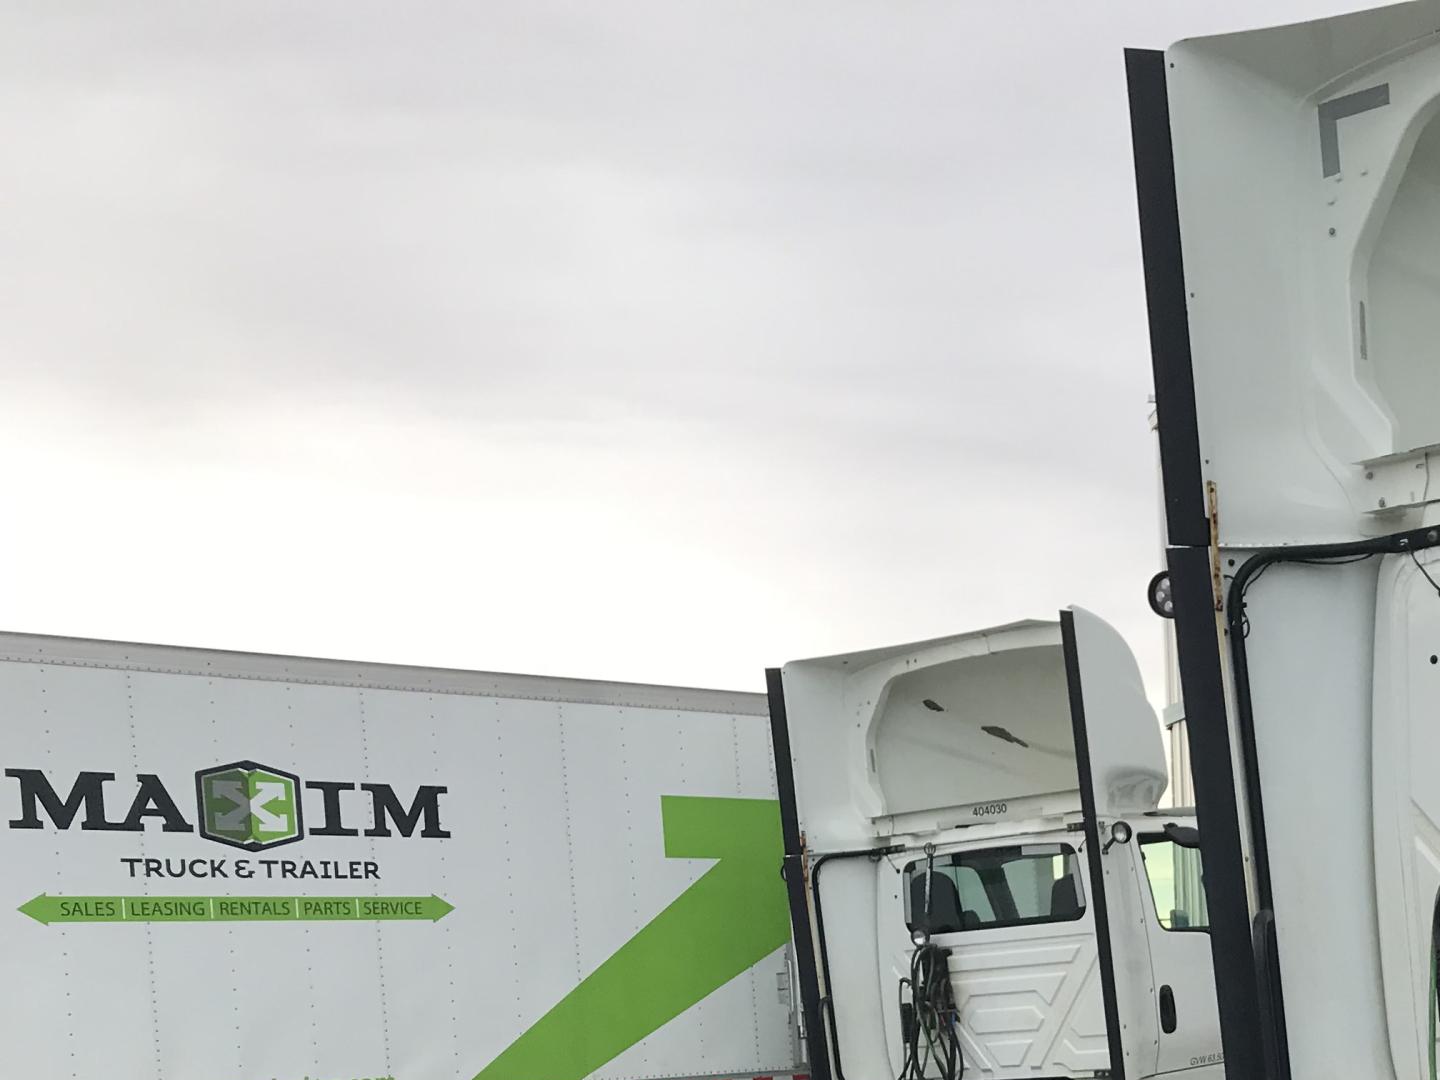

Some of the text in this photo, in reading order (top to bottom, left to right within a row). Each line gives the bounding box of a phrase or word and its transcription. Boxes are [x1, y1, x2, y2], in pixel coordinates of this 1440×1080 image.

[5, 760, 451, 853] MAXIM
[972, 803, 1007, 816] 404030
[120, 858, 381, 880] TRUCK & TRAILER
[60, 902, 422, 917] SALES LEASING RENTALS PARTS SERVICE
